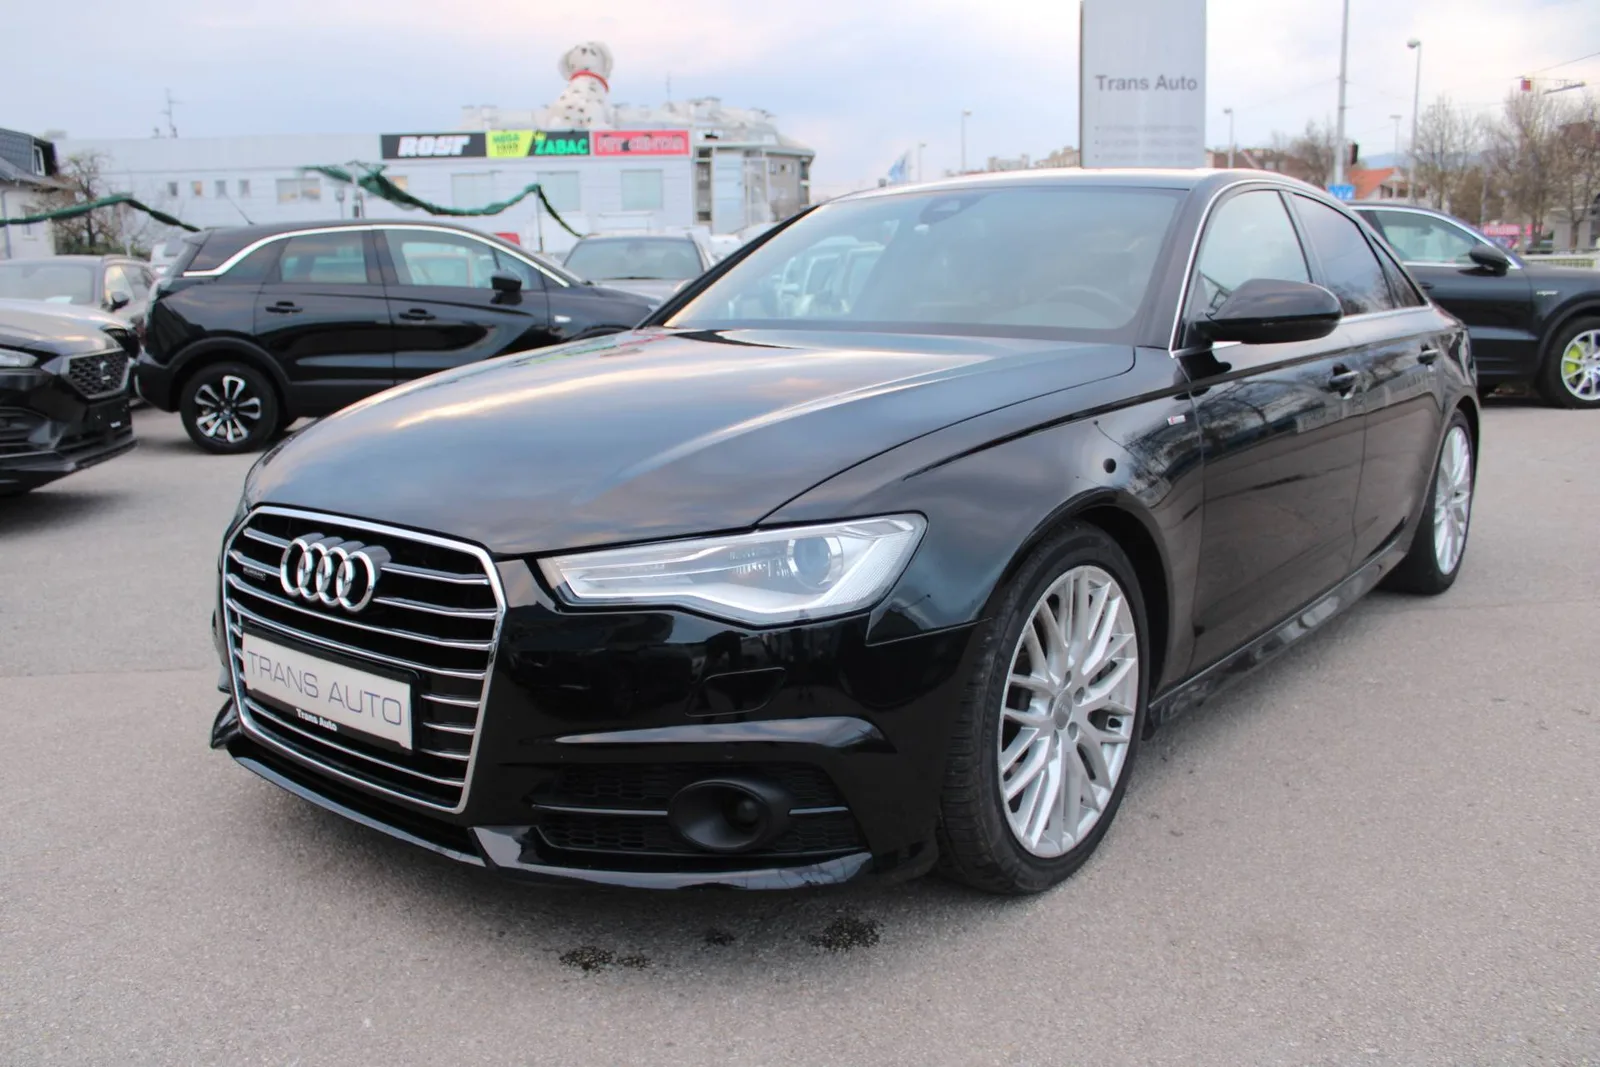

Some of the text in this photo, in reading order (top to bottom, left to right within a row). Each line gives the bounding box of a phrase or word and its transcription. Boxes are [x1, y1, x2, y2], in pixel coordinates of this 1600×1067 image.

[1094, 74, 1198, 91] Trans Auto
[397, 135, 471, 157] ROST
[247, 651, 402, 726] TRANS AUTO
[295, 708, 338, 732] Trans Auto
